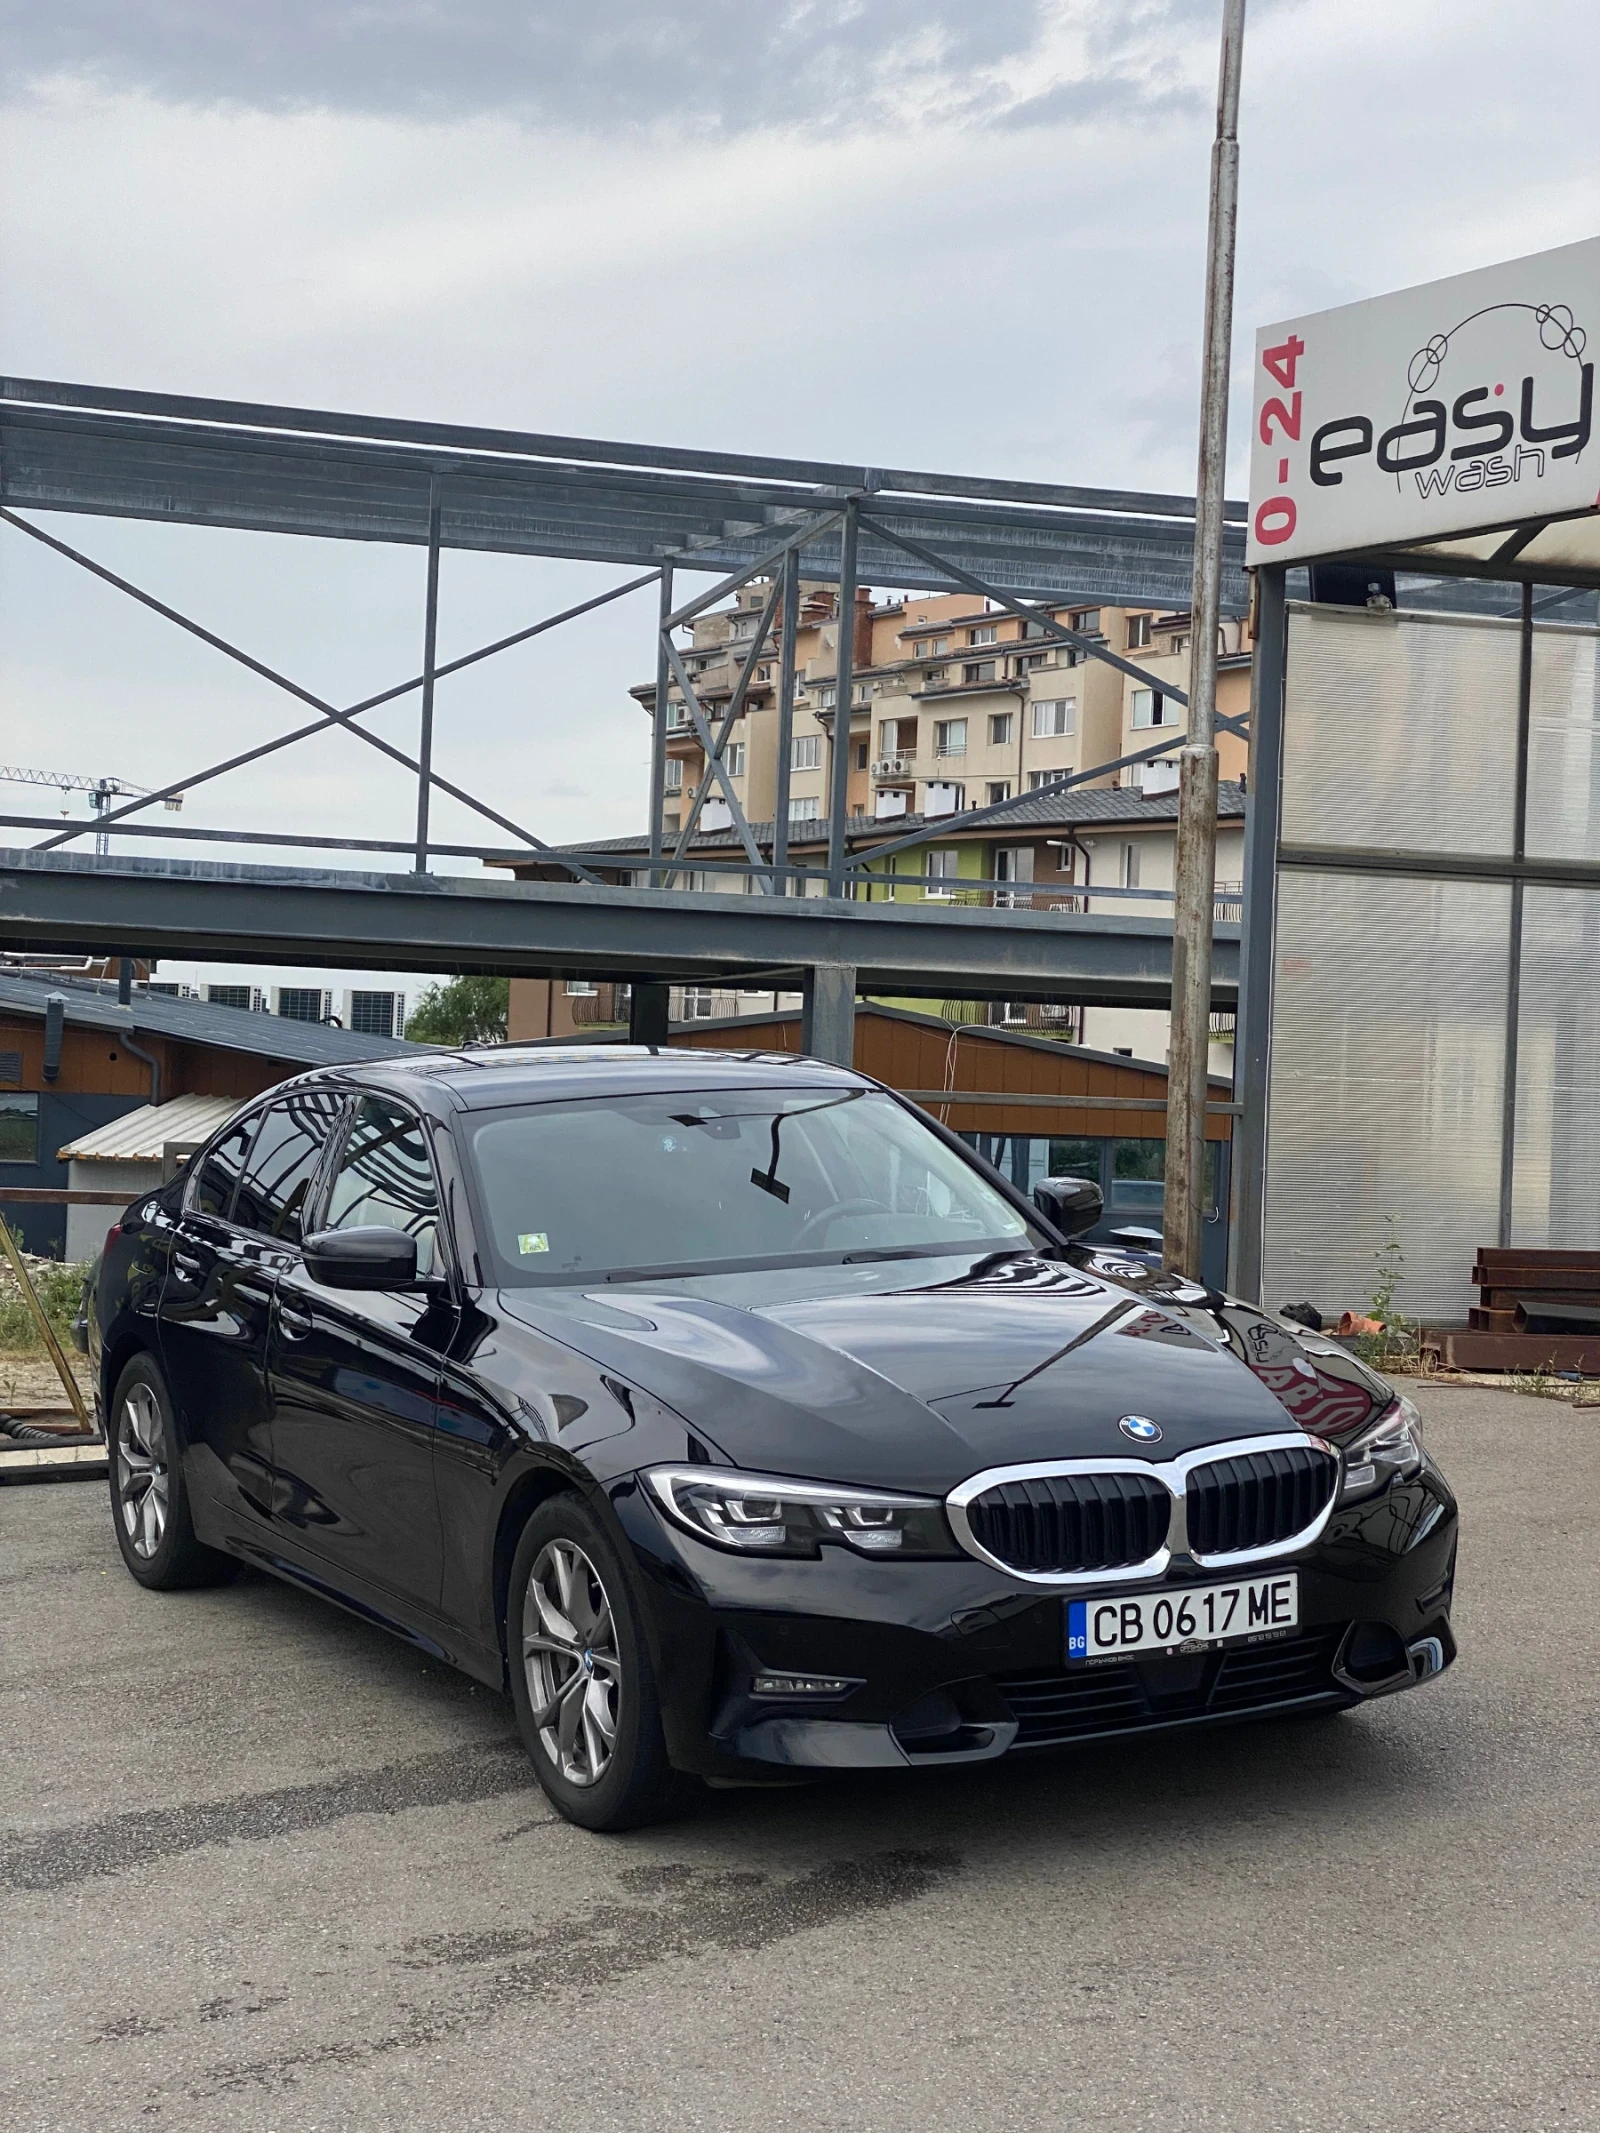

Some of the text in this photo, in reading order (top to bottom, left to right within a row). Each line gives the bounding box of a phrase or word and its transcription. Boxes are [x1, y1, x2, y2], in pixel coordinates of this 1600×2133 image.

[1310, 363, 1594, 487] easy
[1415, 444, 1544, 499] wash
[1069, 1635, 1085, 1650] BG
